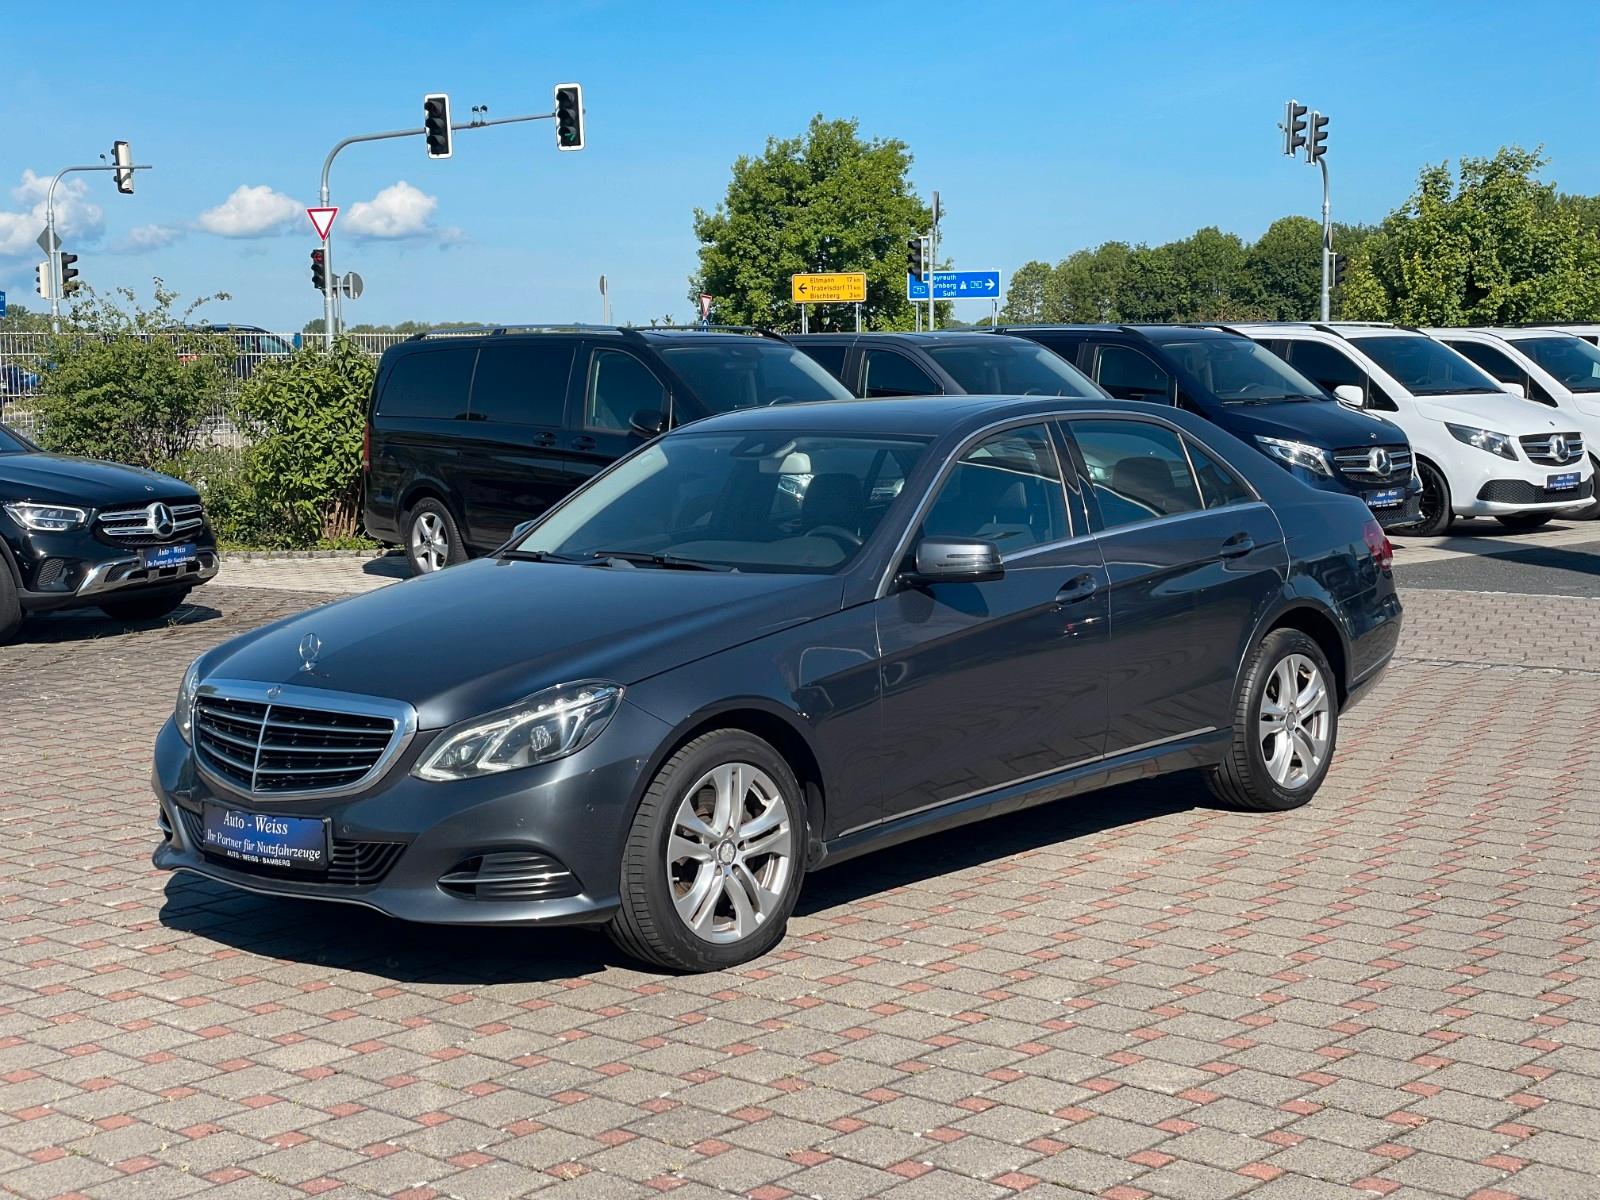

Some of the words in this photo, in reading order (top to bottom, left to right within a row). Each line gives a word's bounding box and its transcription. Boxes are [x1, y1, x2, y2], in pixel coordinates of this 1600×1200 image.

[224, 810, 244, 829] Auto
[255, 817, 288, 835] Weiss
[207, 829, 216, 840] Ihr
[217, 832, 242, 848] Partner
[243, 838, 255, 852] für
[256, 840, 320, 862] Nutzfahrzeuge
[227, 850, 239, 859] AUTO
[243, 854, 258, 862] WEISS
[262, 858, 291, 867] BAMBERG
